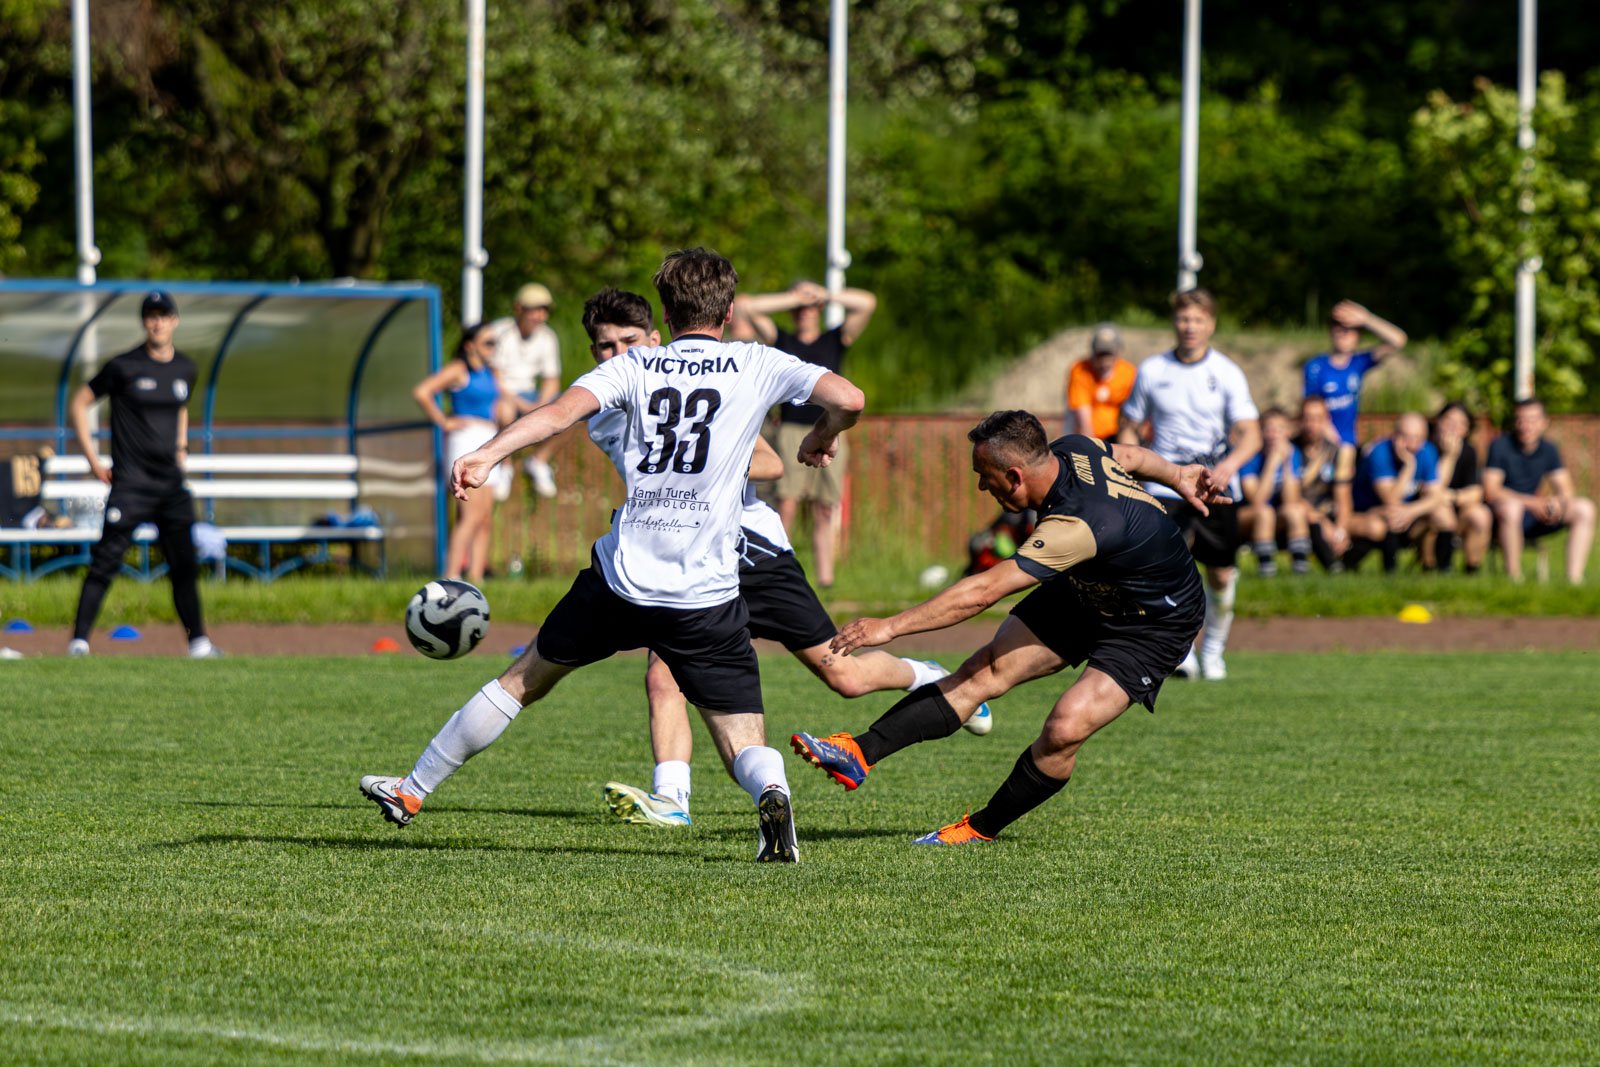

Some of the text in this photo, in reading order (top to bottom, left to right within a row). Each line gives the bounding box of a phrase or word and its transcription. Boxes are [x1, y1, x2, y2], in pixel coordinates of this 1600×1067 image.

[643, 356, 739, 377] VICTORIA
[636, 386, 721, 474] 33
[633, 486, 699, 501] Kamil Turek
